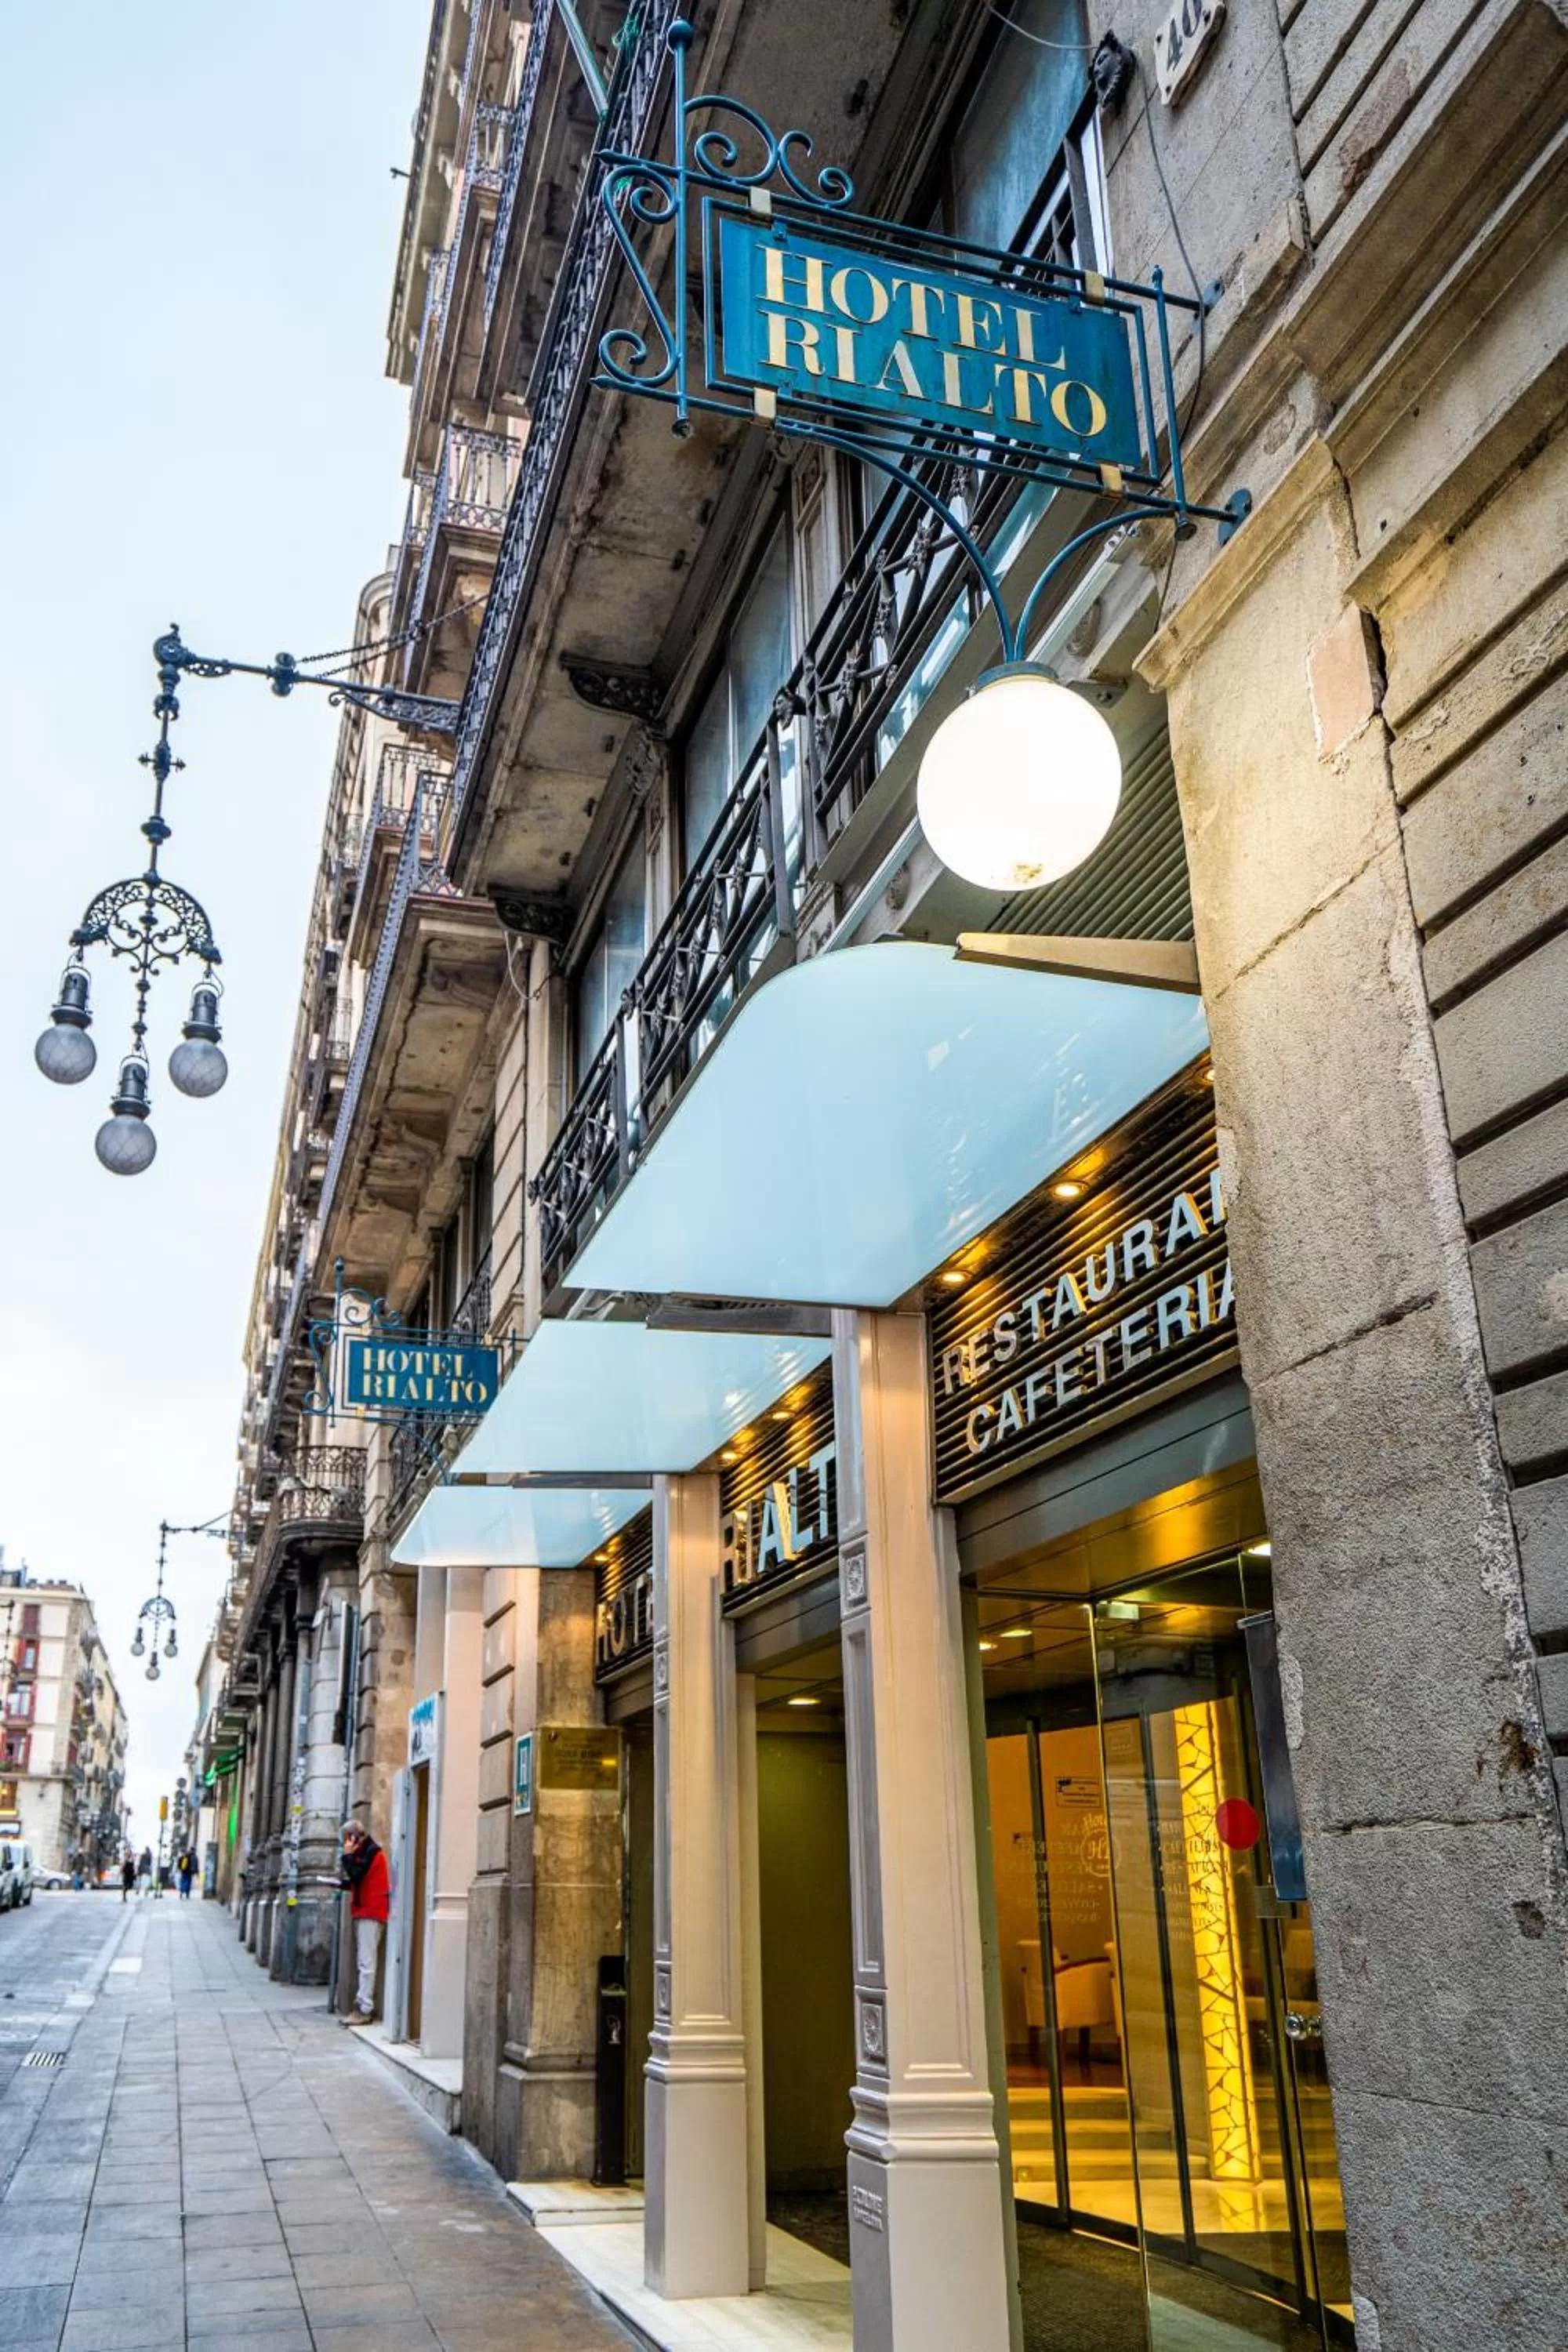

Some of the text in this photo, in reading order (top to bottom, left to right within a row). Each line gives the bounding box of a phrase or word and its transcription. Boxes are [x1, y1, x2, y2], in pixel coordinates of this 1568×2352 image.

[755, 243, 1065, 371] HOTEL
[757, 310, 1107, 437] RIALTO
[363, 1347, 474, 1377] HOTEL
[363, 1373, 488, 1403] RIALTO
